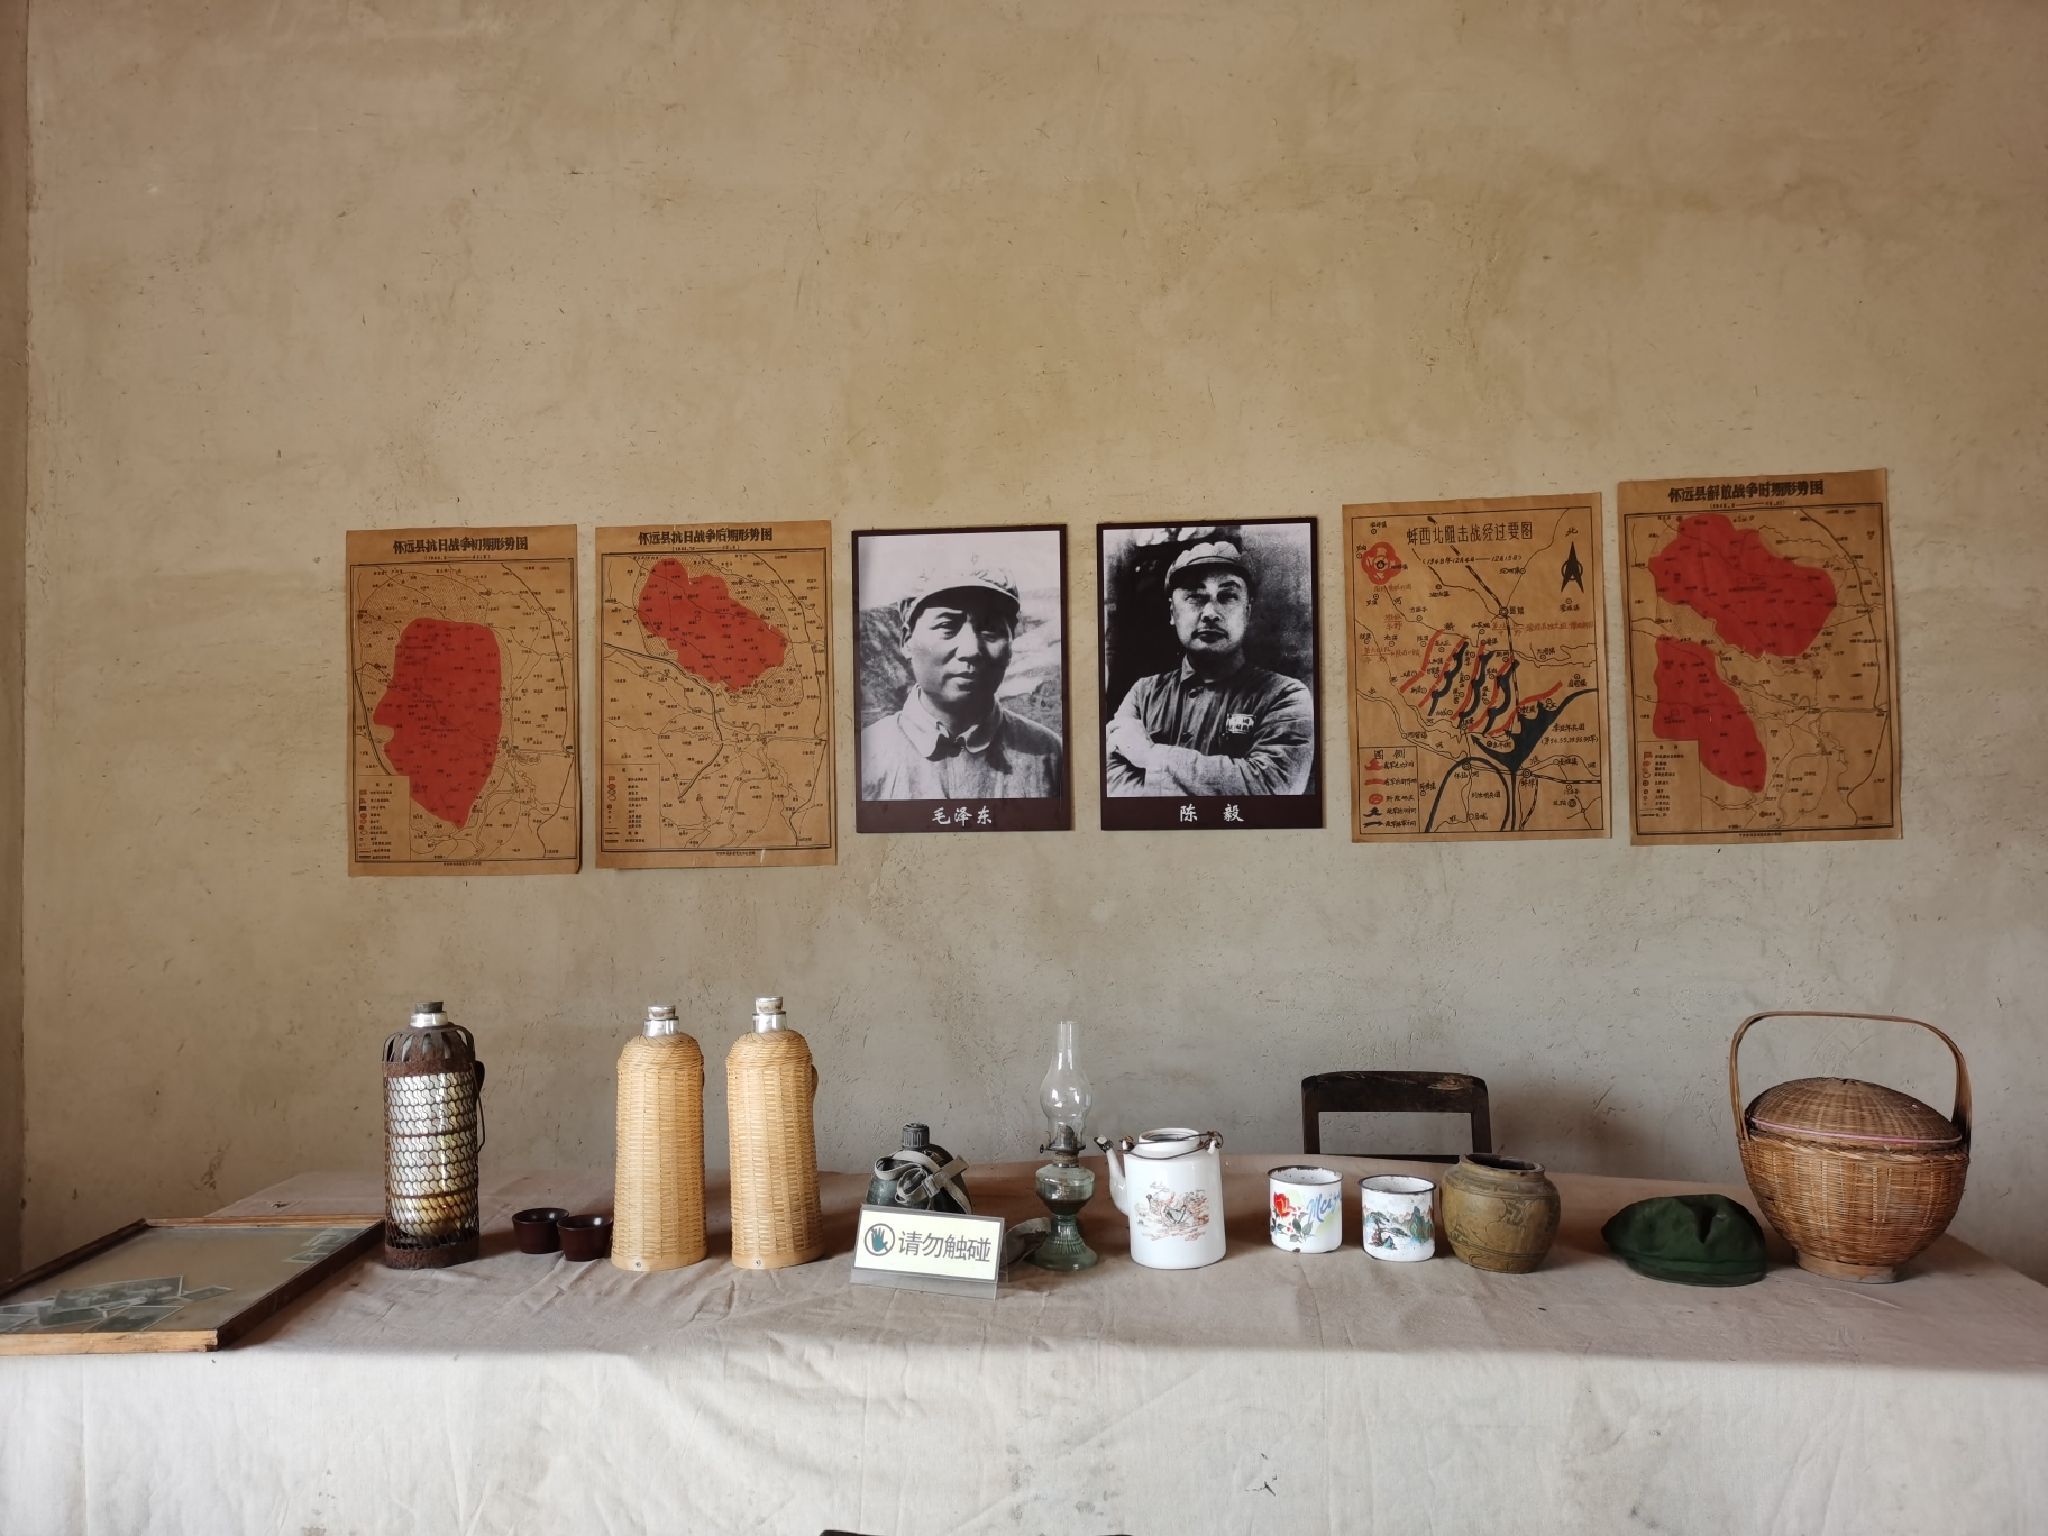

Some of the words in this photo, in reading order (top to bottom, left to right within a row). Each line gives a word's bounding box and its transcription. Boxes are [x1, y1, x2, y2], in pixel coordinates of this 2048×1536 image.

[1667, 479, 1824, 503] 怀远县解放战争时期形势图
[638, 527, 773, 546] 怀远县抗日战争后期形势图
[1407, 521, 1533, 546] 蚌西北阻击战经过要图
[393, 536, 529, 555] 怀远县抗日战争初期形势图
[932, 805, 992, 827] 毛泽东
[1179, 803, 1245, 823] 陈毅
[898, 1231, 992, 1262] 请勿触碰
